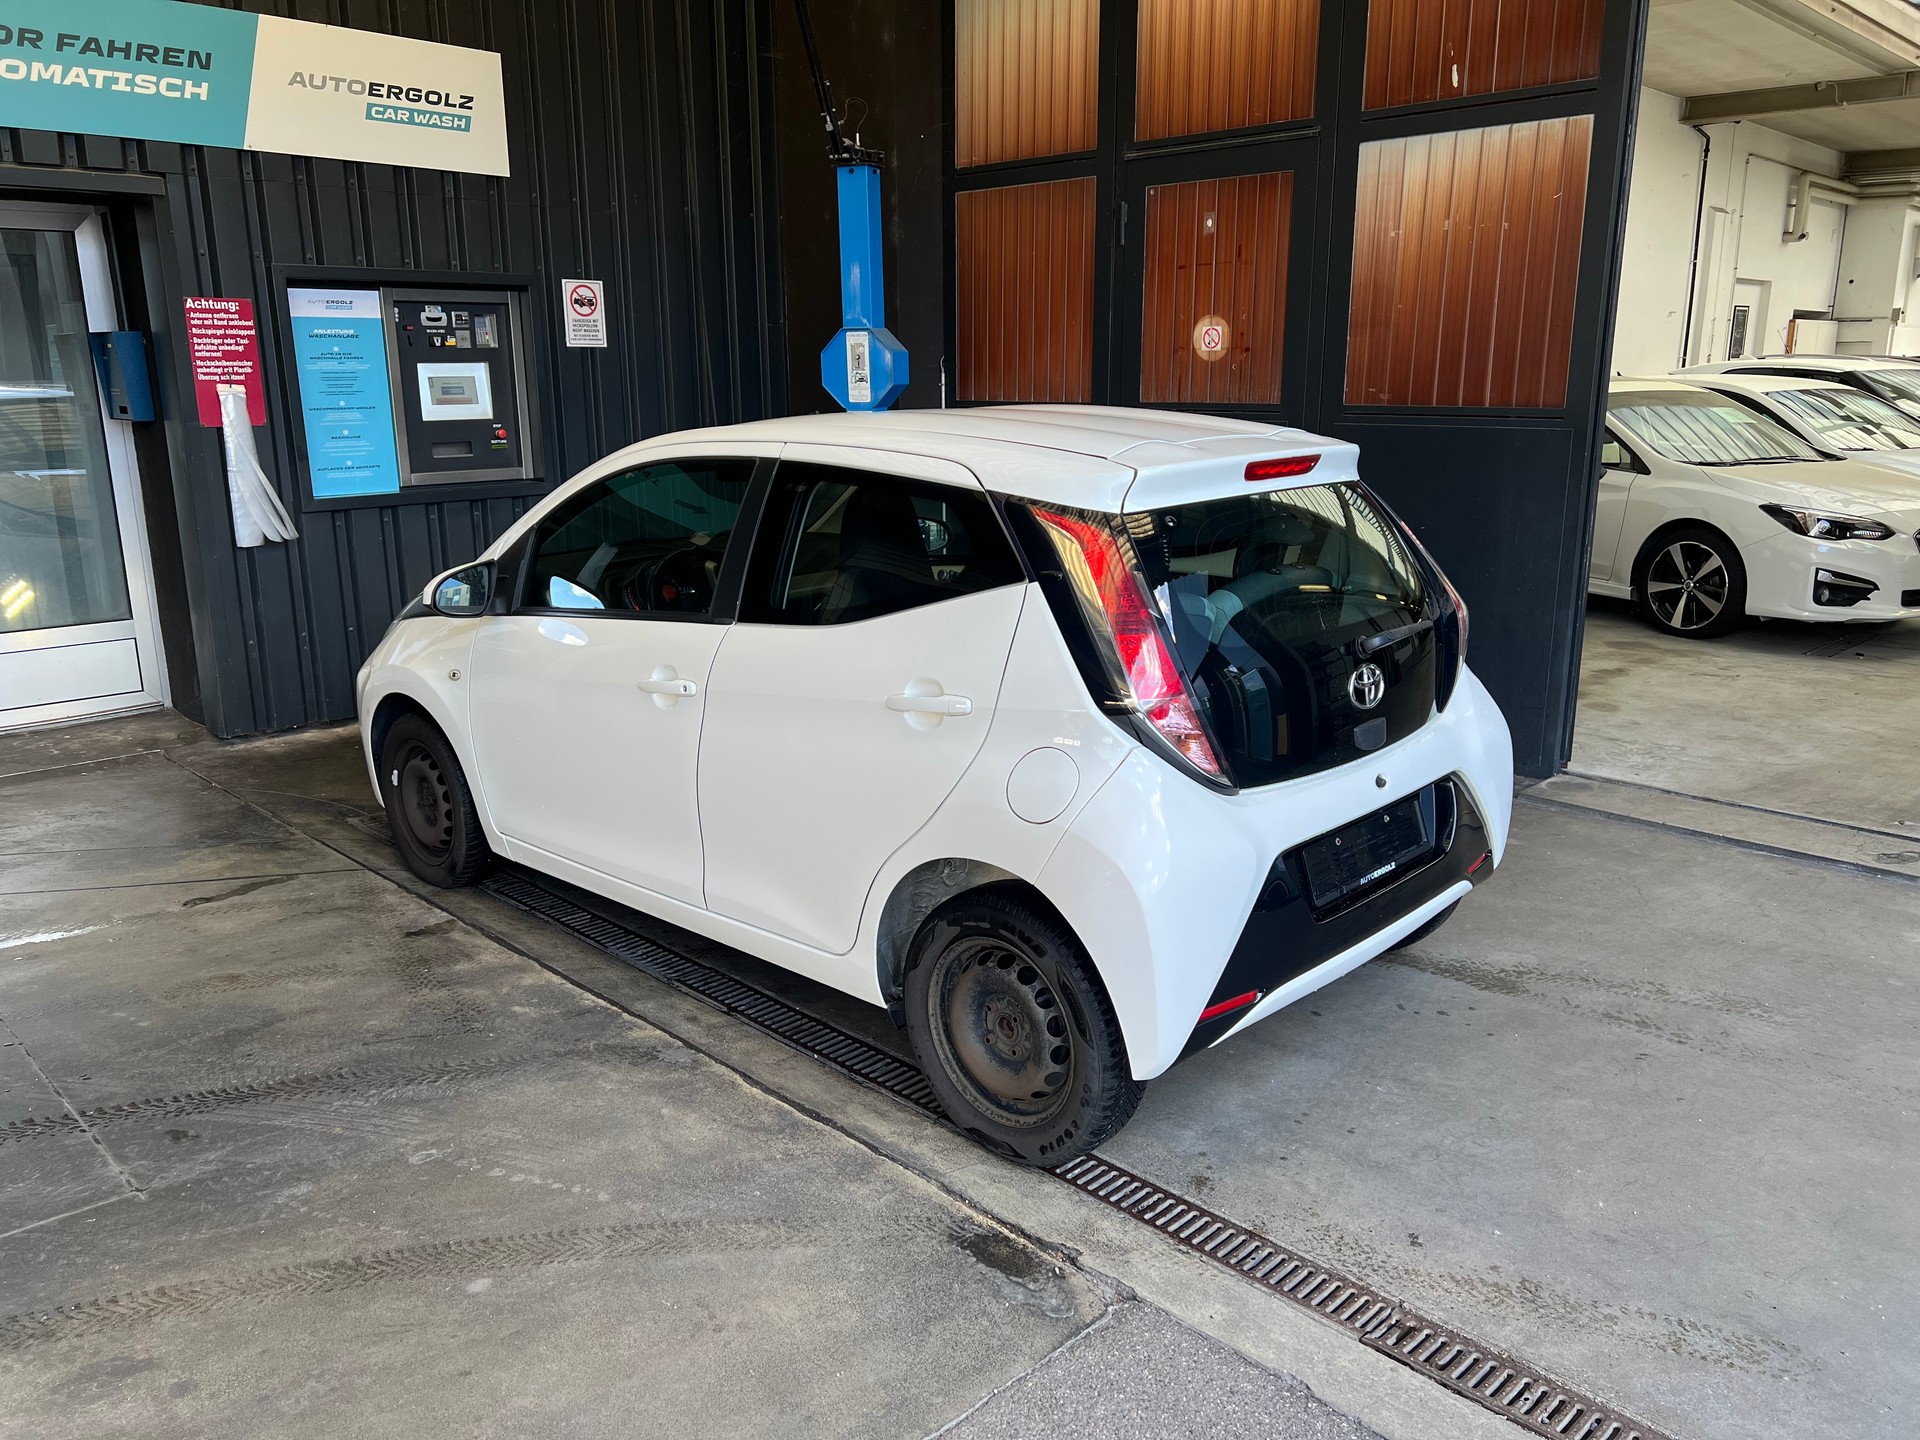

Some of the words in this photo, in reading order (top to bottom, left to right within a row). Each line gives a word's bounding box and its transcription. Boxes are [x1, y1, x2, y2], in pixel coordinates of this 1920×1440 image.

[56, 33, 212, 70] FAHREN
[288, 71, 474, 110] AUTOERGOLZ
[370, 106, 410, 122] CAR
[414, 112, 466, 129] WASH
[186, 298, 240, 312] Achtung:
